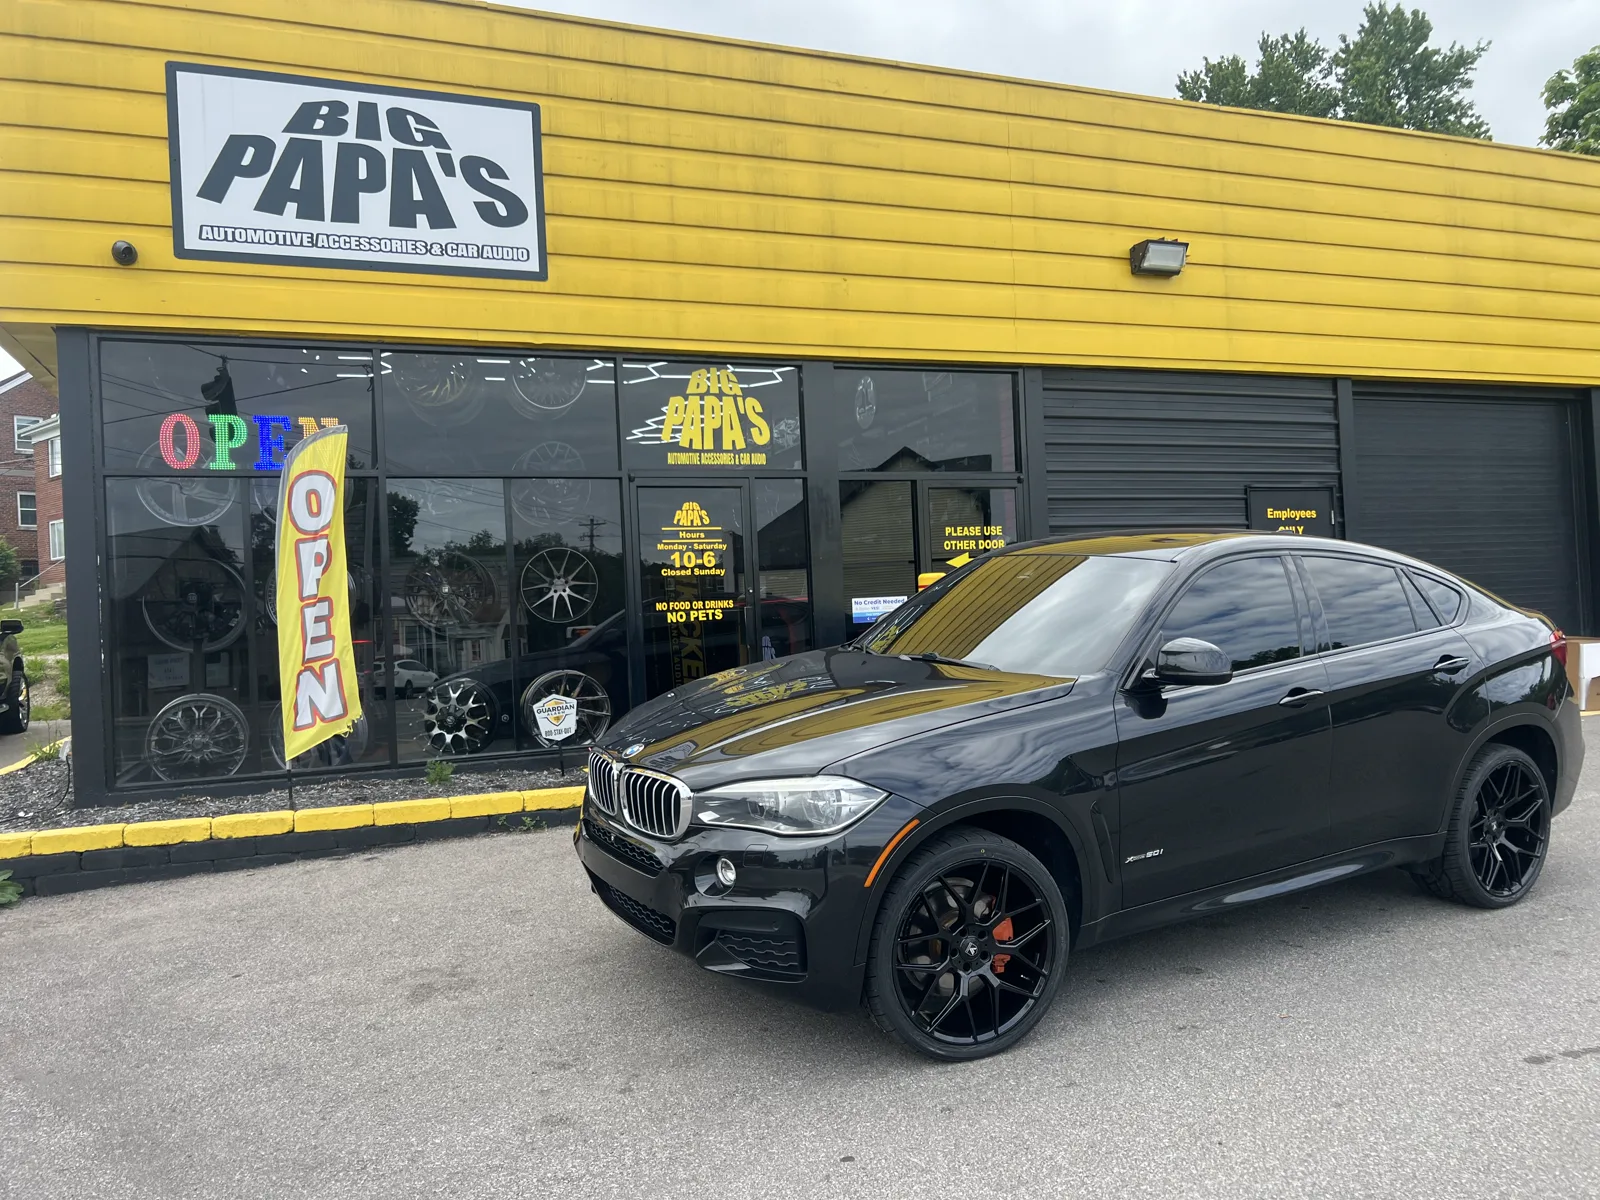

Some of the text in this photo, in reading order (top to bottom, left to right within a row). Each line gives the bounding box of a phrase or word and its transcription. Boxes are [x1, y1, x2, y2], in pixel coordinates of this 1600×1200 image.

[282, 100, 452, 150] BIG
[196, 134, 529, 229] PAPA'S
[199, 225, 530, 262] AUTOMOTIVE ACCESSORIES & CAR AUDIO
[686, 367, 743, 396] BIG
[661, 395, 770, 450] PAPA'S
[667, 452, 767, 465] AUTOMOTIVE ACCESSORIES & CAR AUDIO
[681, 501, 701, 511] BIG
[673, 510, 710, 527] PAPA'S
[1267, 508, 1317, 520] Employees
[679, 531, 705, 539] Hours
[945, 525, 1003, 536] PLEASE USE
[657, 543, 687, 551] Monday
[693, 542, 727, 551] Saturday
[943, 539, 1005, 550] OTHER DOOR
[670, 551, 716, 568] 10-6
[661, 567, 726, 577] Closed Sunday
[288, 470, 348, 731] OPEN
[655, 600, 734, 611] NO FOOD OR DRINKS
[666, 609, 723, 623] NO PETS
[536, 704, 575, 715] GUARDIAN
